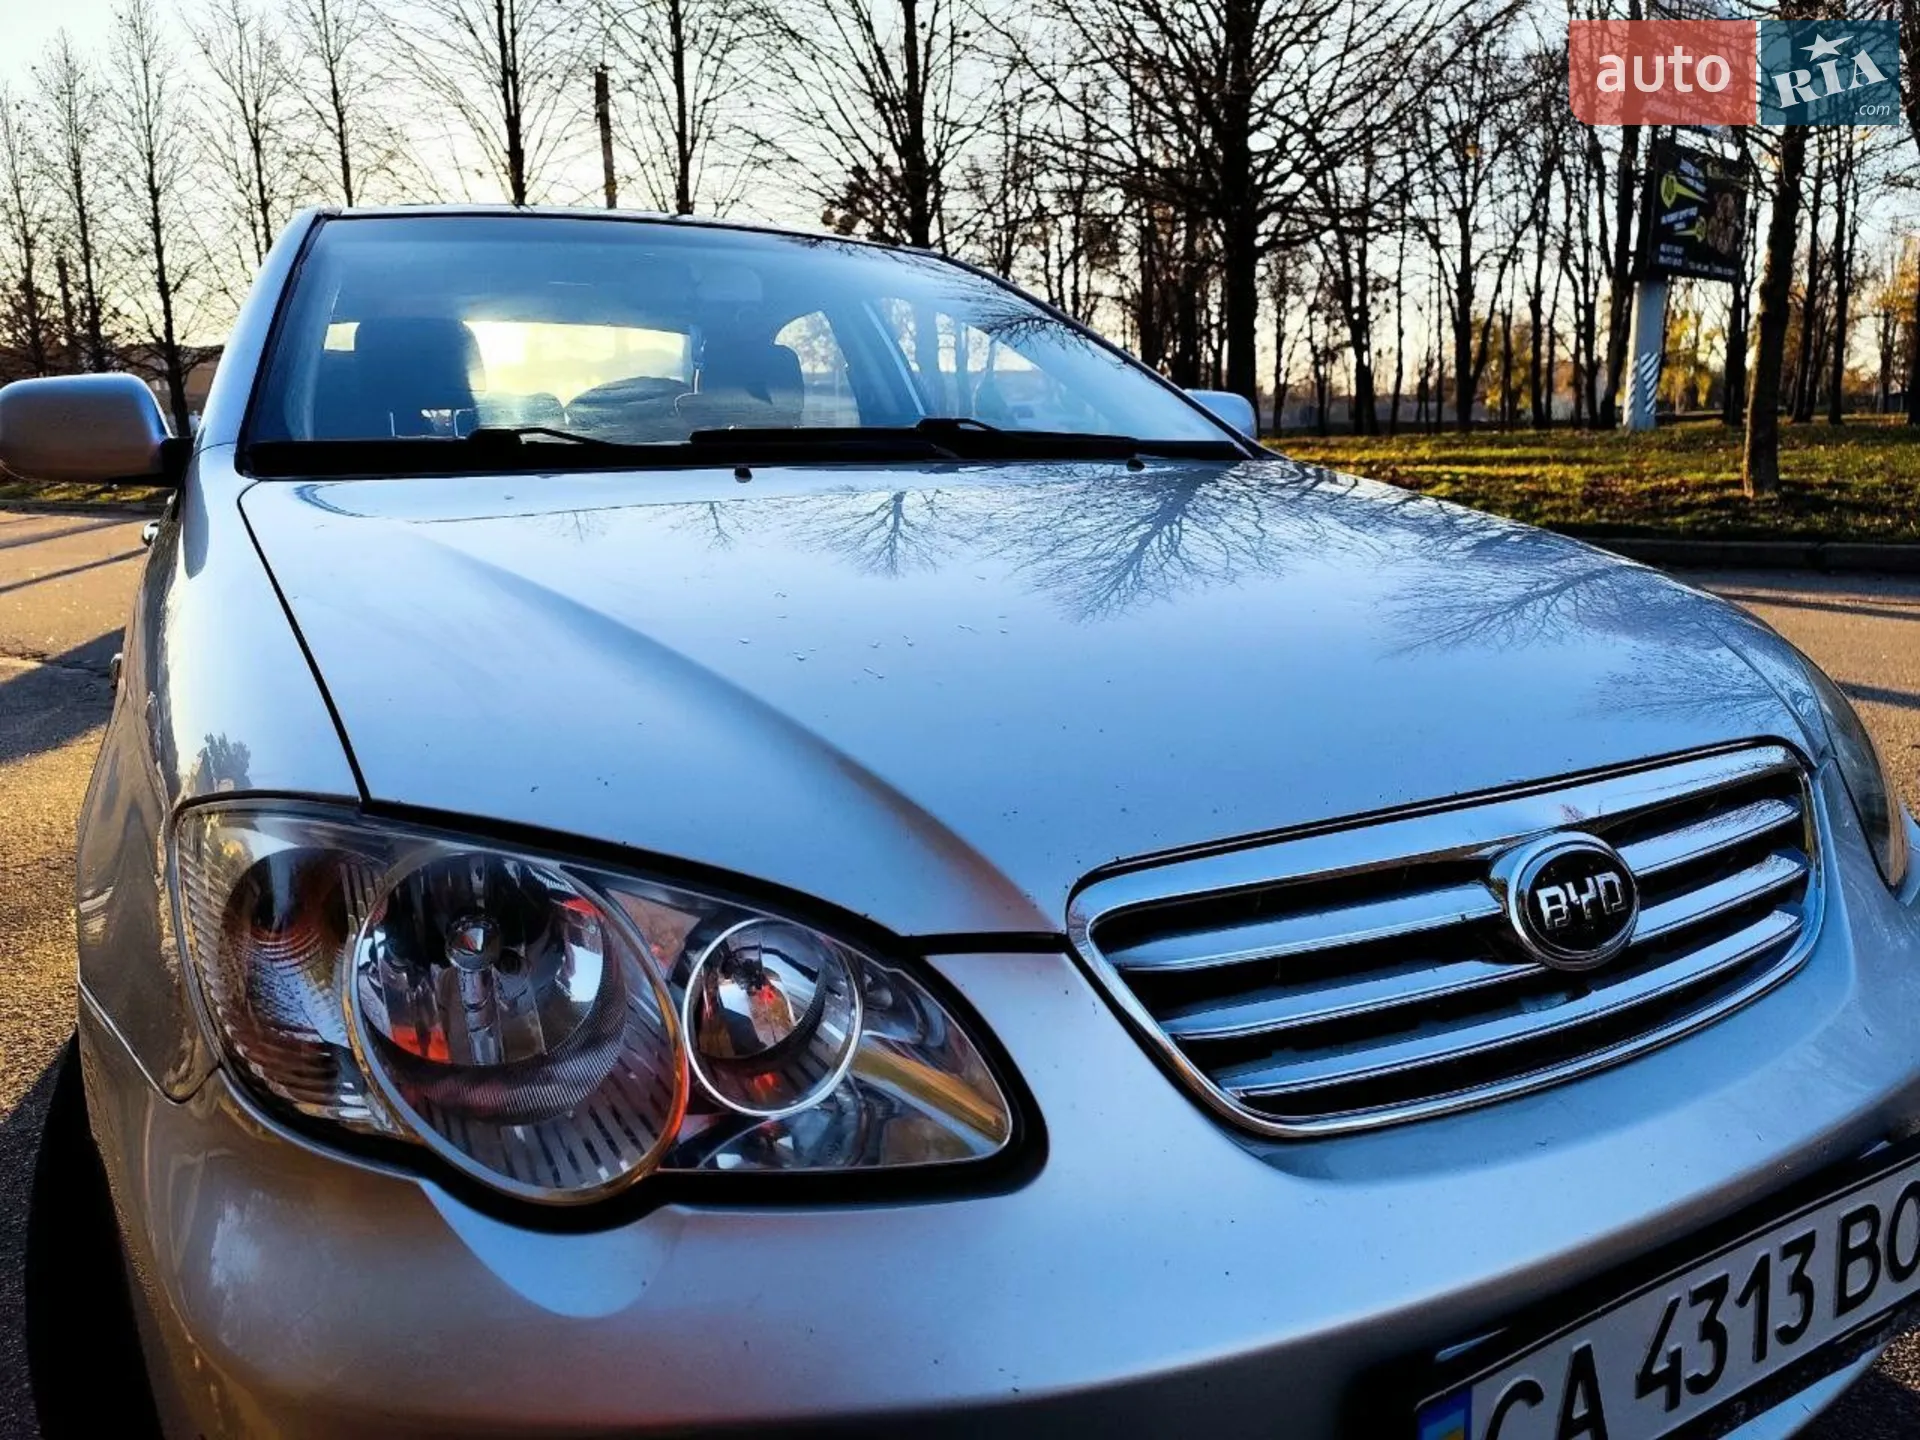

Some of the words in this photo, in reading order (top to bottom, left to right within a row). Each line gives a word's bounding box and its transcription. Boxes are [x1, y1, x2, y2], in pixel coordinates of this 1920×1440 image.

[1536, 871, 1626, 930] BYD
[1484, 1341, 1609, 1440] CA
[1635, 1229, 1816, 1412] 4313
